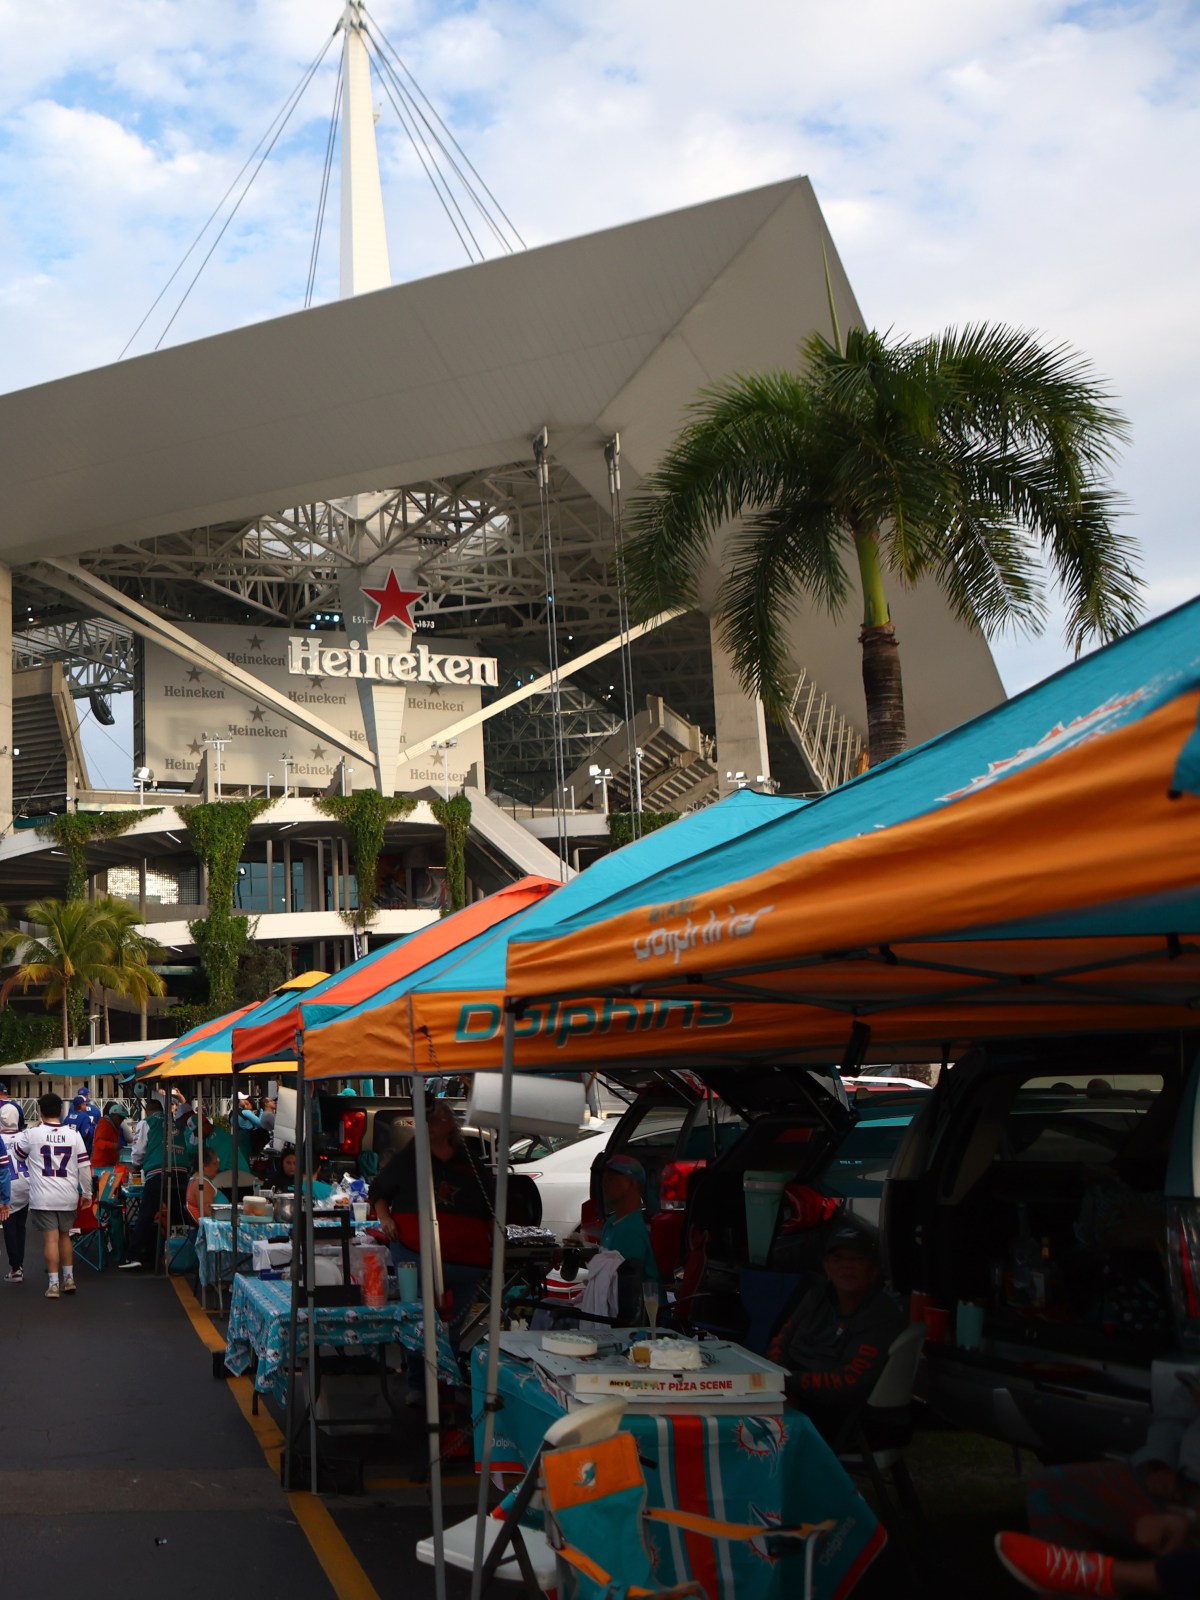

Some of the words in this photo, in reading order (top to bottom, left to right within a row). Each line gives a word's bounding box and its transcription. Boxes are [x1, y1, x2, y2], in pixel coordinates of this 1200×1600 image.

[227, 652, 286, 667] Heineken
[288, 636, 498, 687] Heineken
[164, 685, 225, 699] Heineken
[288, 691, 346, 705] Heineken
[407, 697, 464, 712] Heineken
[228, 724, 288, 738] Heineken
[455, 1000, 735, 1048] Dolphins
[46, 1134, 66, 1144] ALLEN
[39, 1145, 73, 1178] 17
[669, 1381, 697, 1391] PIZZA
[700, 1380, 732, 1389] SCENE
